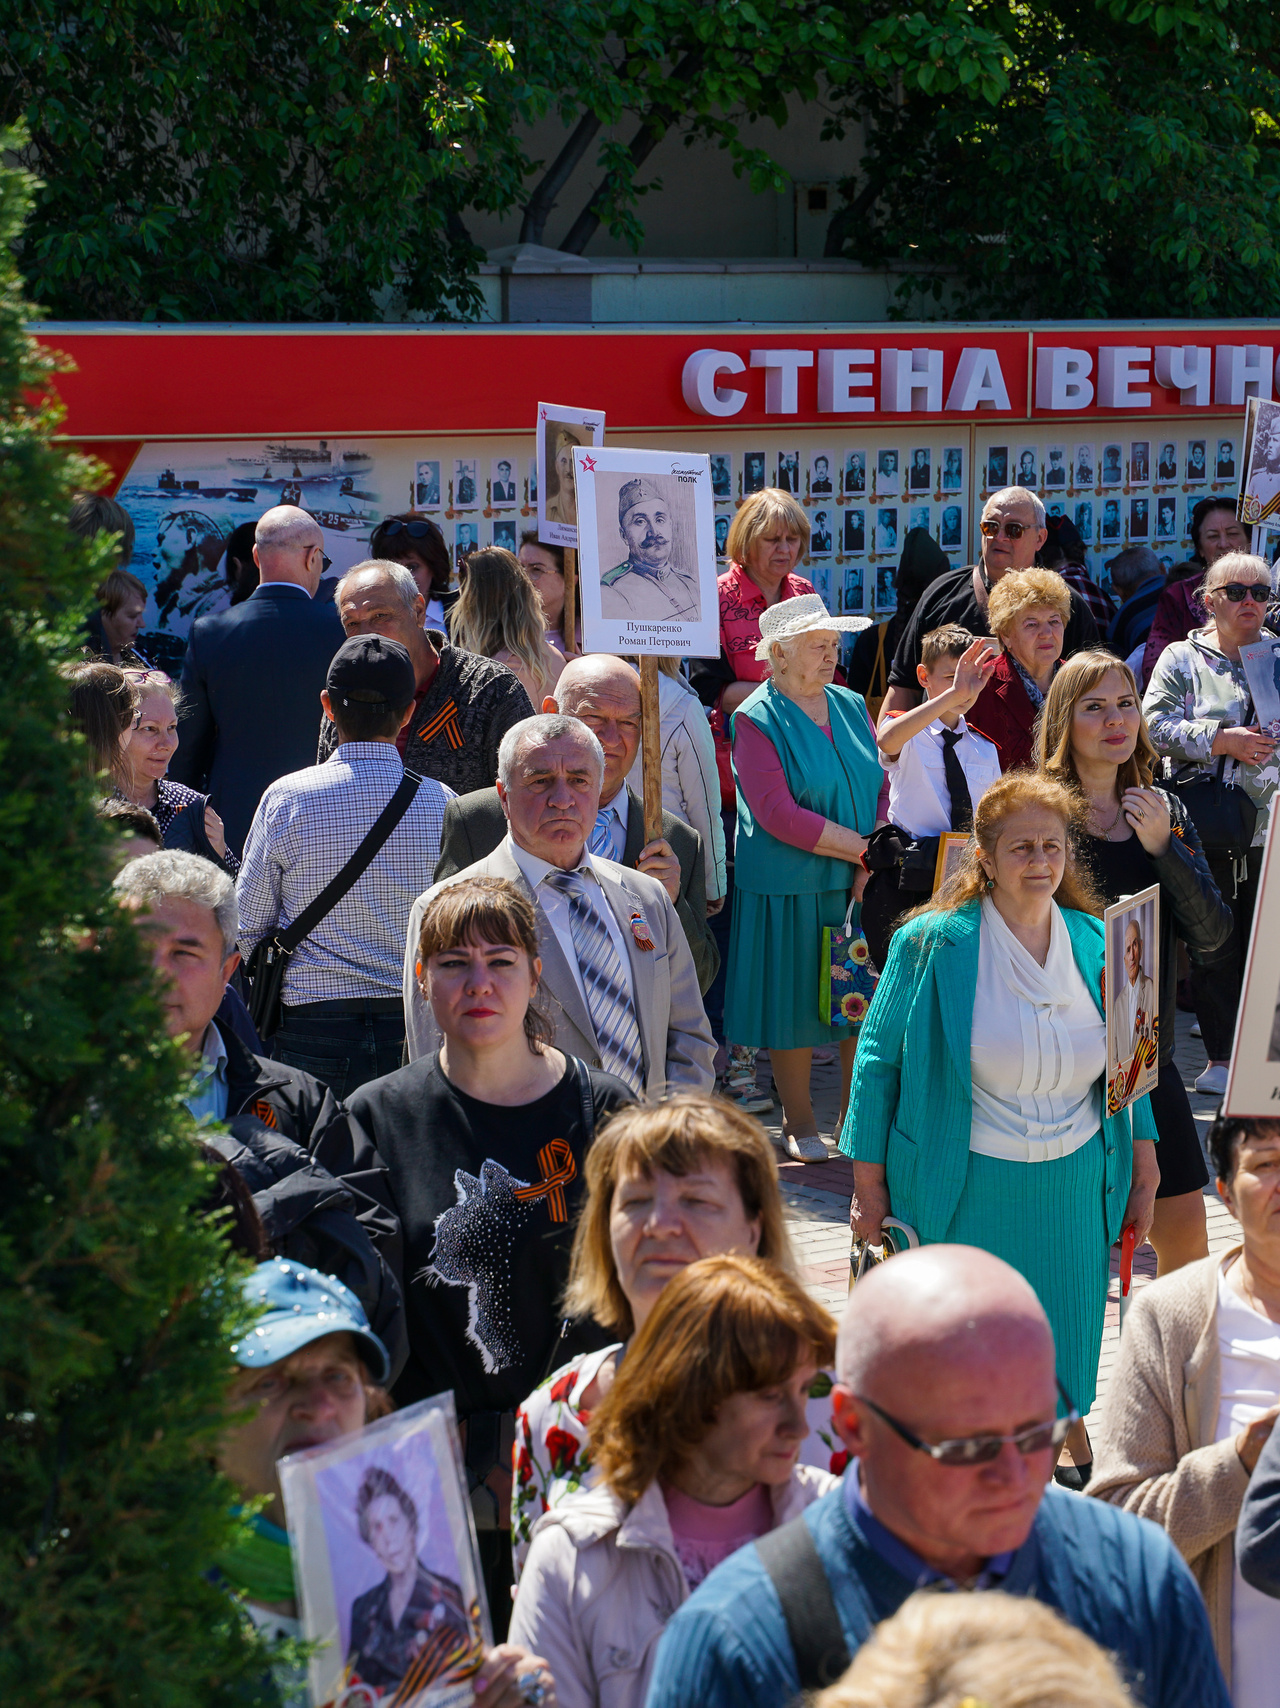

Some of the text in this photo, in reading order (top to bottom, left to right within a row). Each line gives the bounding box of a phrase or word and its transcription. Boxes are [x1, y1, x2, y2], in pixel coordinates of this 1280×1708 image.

[681, 348, 1011, 416] СТЕНА
[678, 476, 698, 484] ПОЛК
[328, 513, 339, 525] 25
[627, 622, 682, 634] Пушкаренко
[619, 636, 691, 648] Роман Петрович
